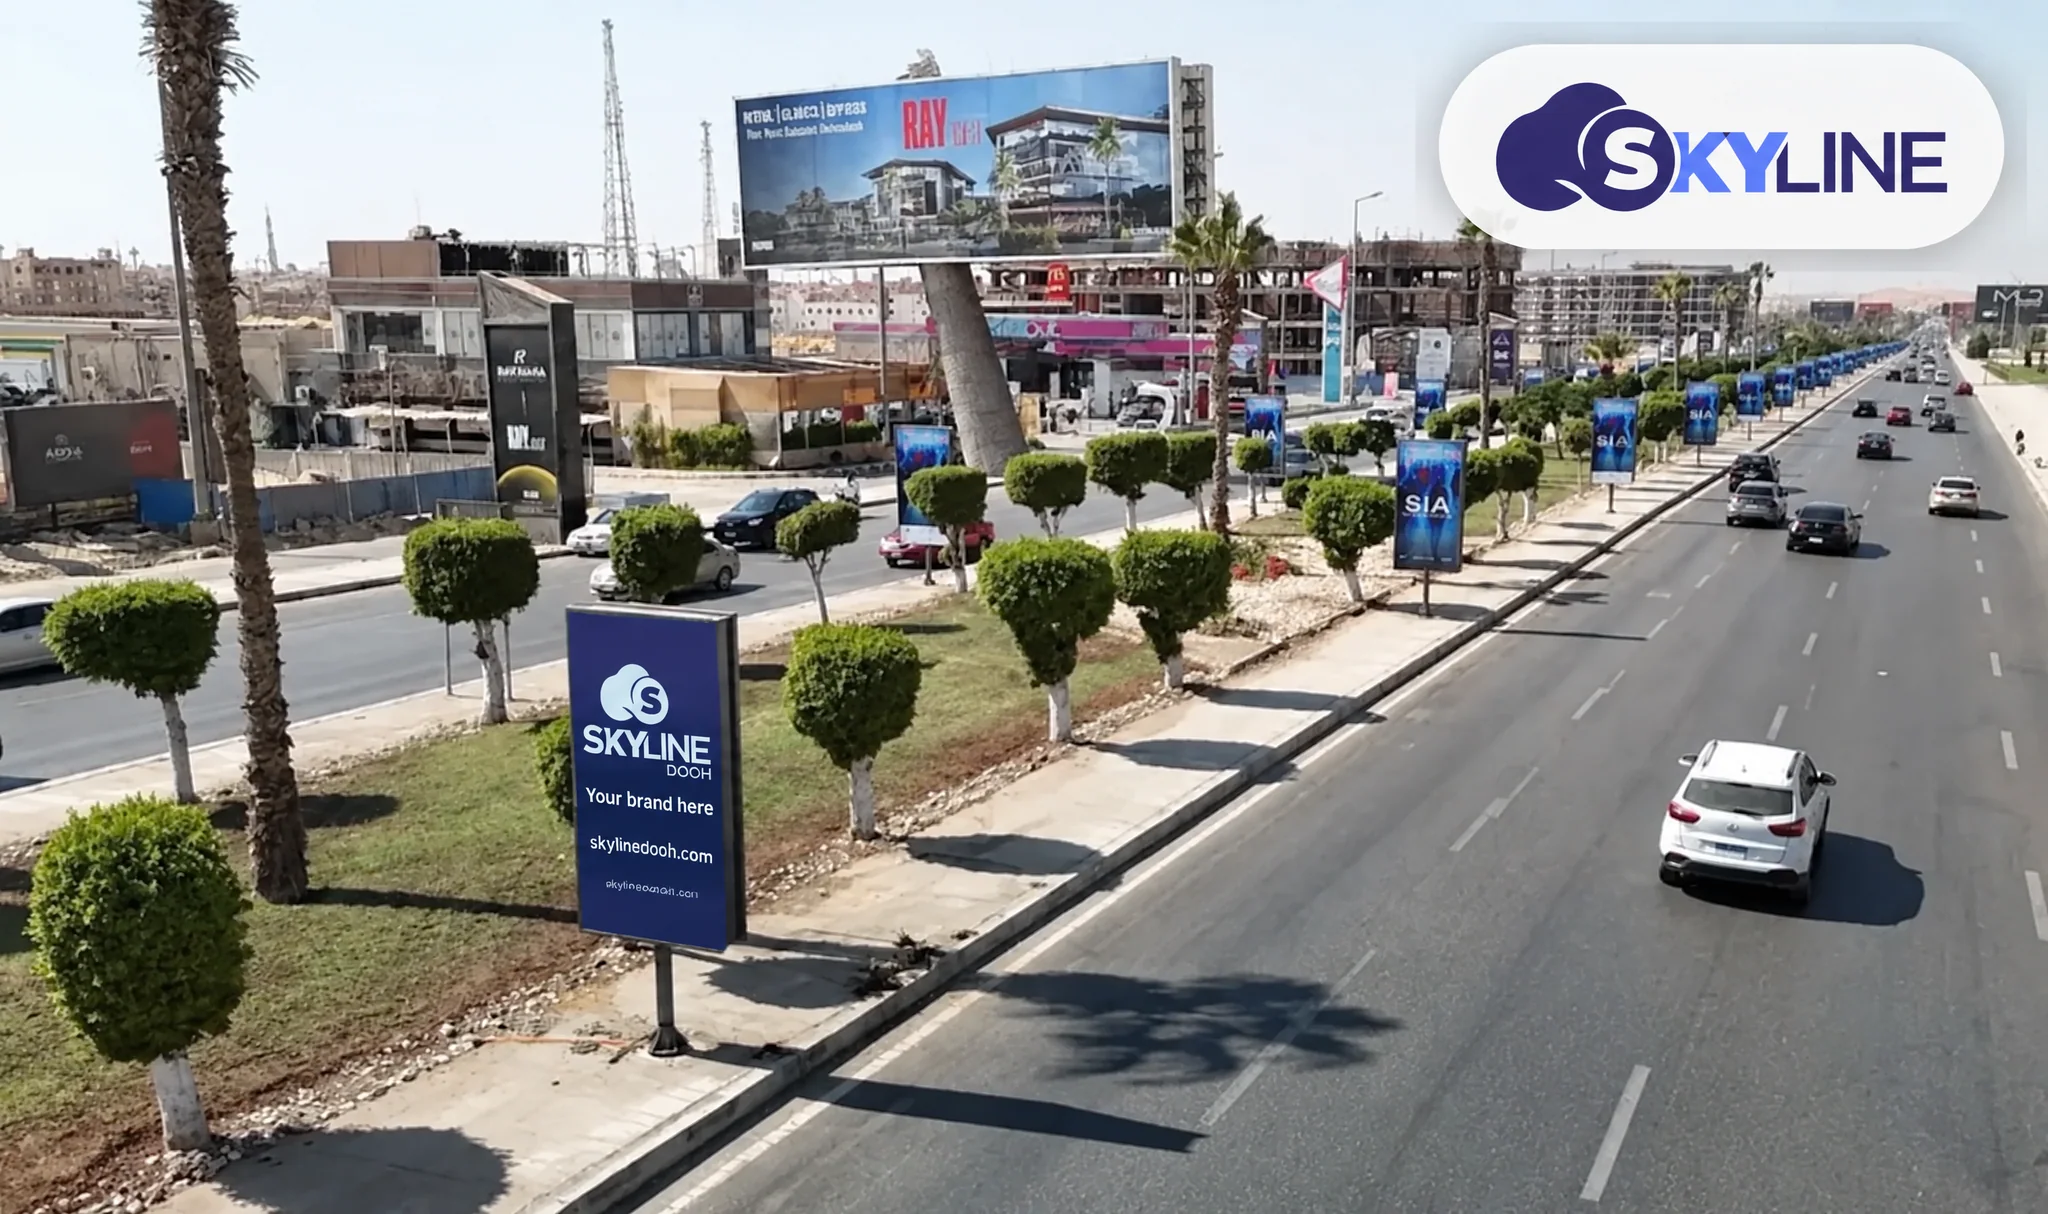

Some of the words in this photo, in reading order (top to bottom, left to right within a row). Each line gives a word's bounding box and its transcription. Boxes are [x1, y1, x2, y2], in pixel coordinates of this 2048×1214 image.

[903, 98, 948, 150] RAY
[1689, 408, 1713, 420] SIA
[1596, 434, 1629, 448] SIA
[1405, 494, 1450, 514] SIA
[640, 686, 662, 715] S
[583, 724, 711, 765] SKYLINE
[666, 764, 712, 780] DOOH
[585, 787, 622, 806] Your
[627, 790, 673, 812] brand
[677, 797, 714, 816] here
[589, 835, 713, 864] skylinedooh.com
